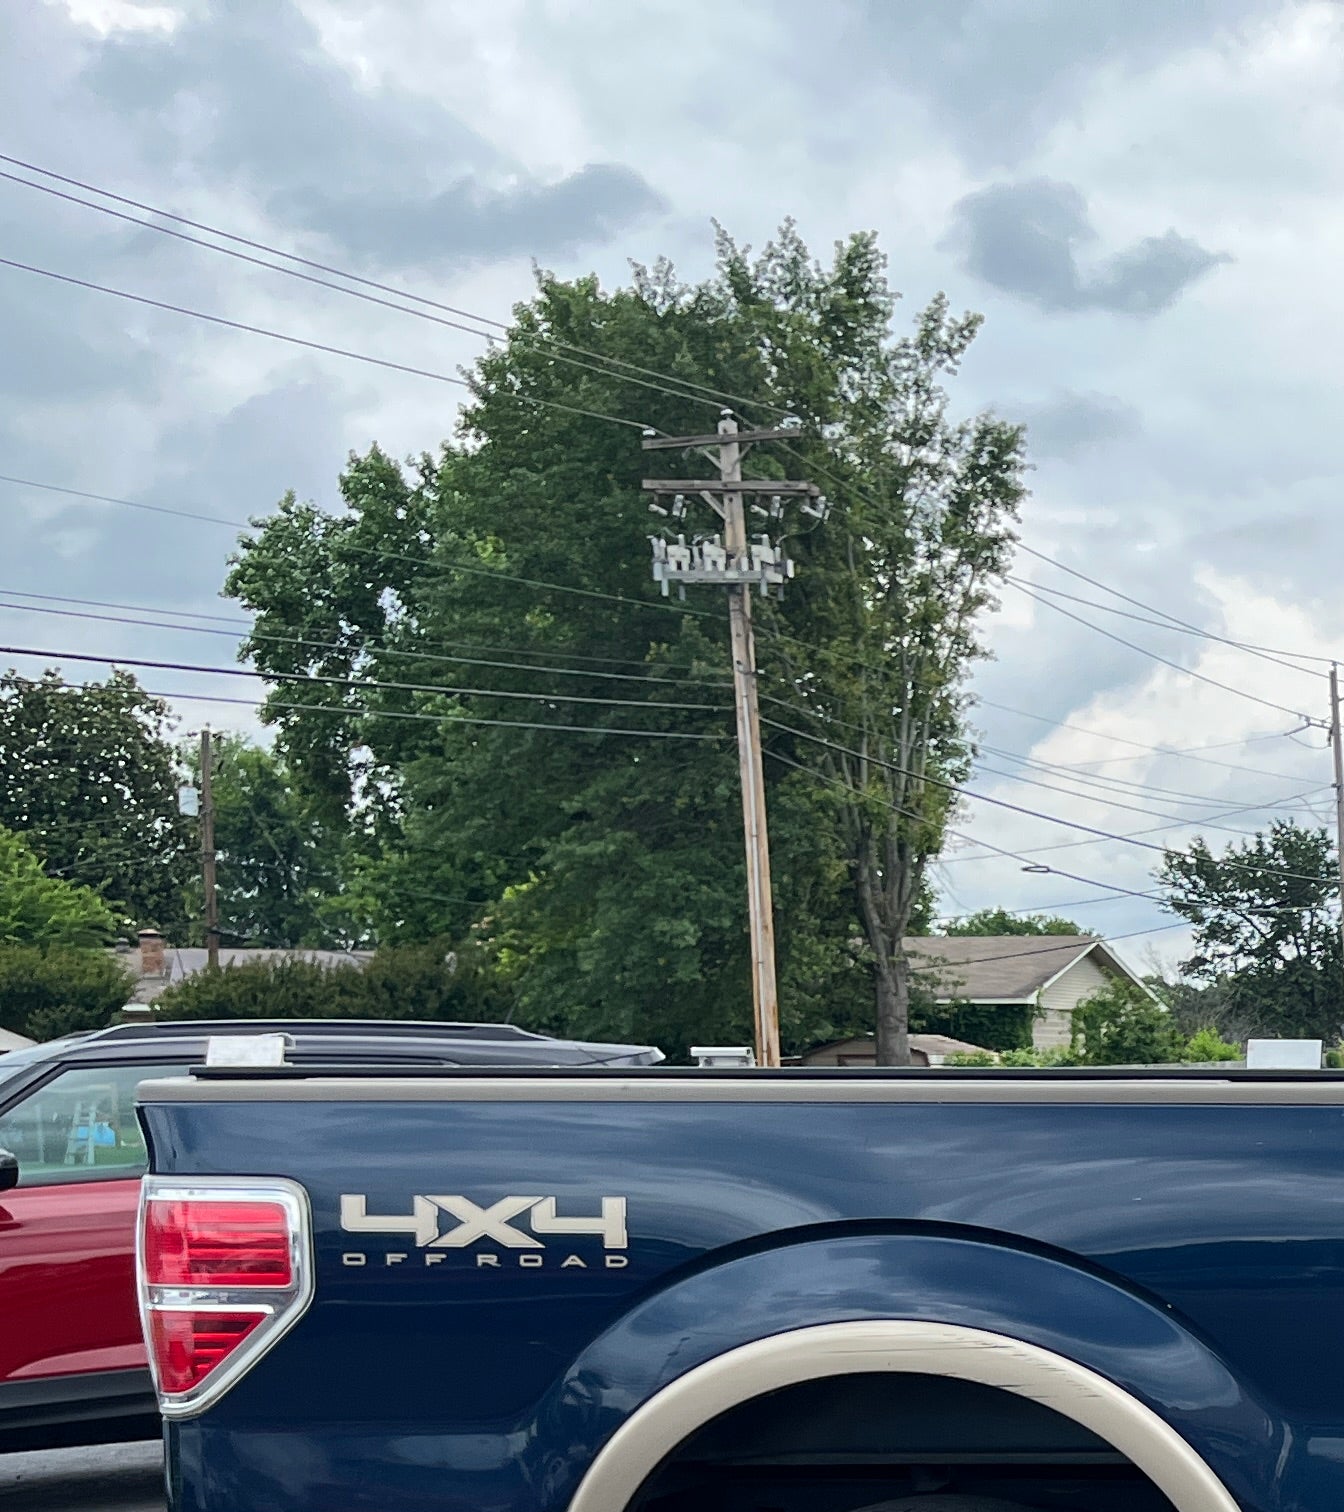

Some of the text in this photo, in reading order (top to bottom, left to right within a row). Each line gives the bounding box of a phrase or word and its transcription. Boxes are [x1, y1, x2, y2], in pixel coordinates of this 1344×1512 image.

[340, 1194, 628, 1248] 4X4
[342, 1253, 628, 1267] OFF ROAD
